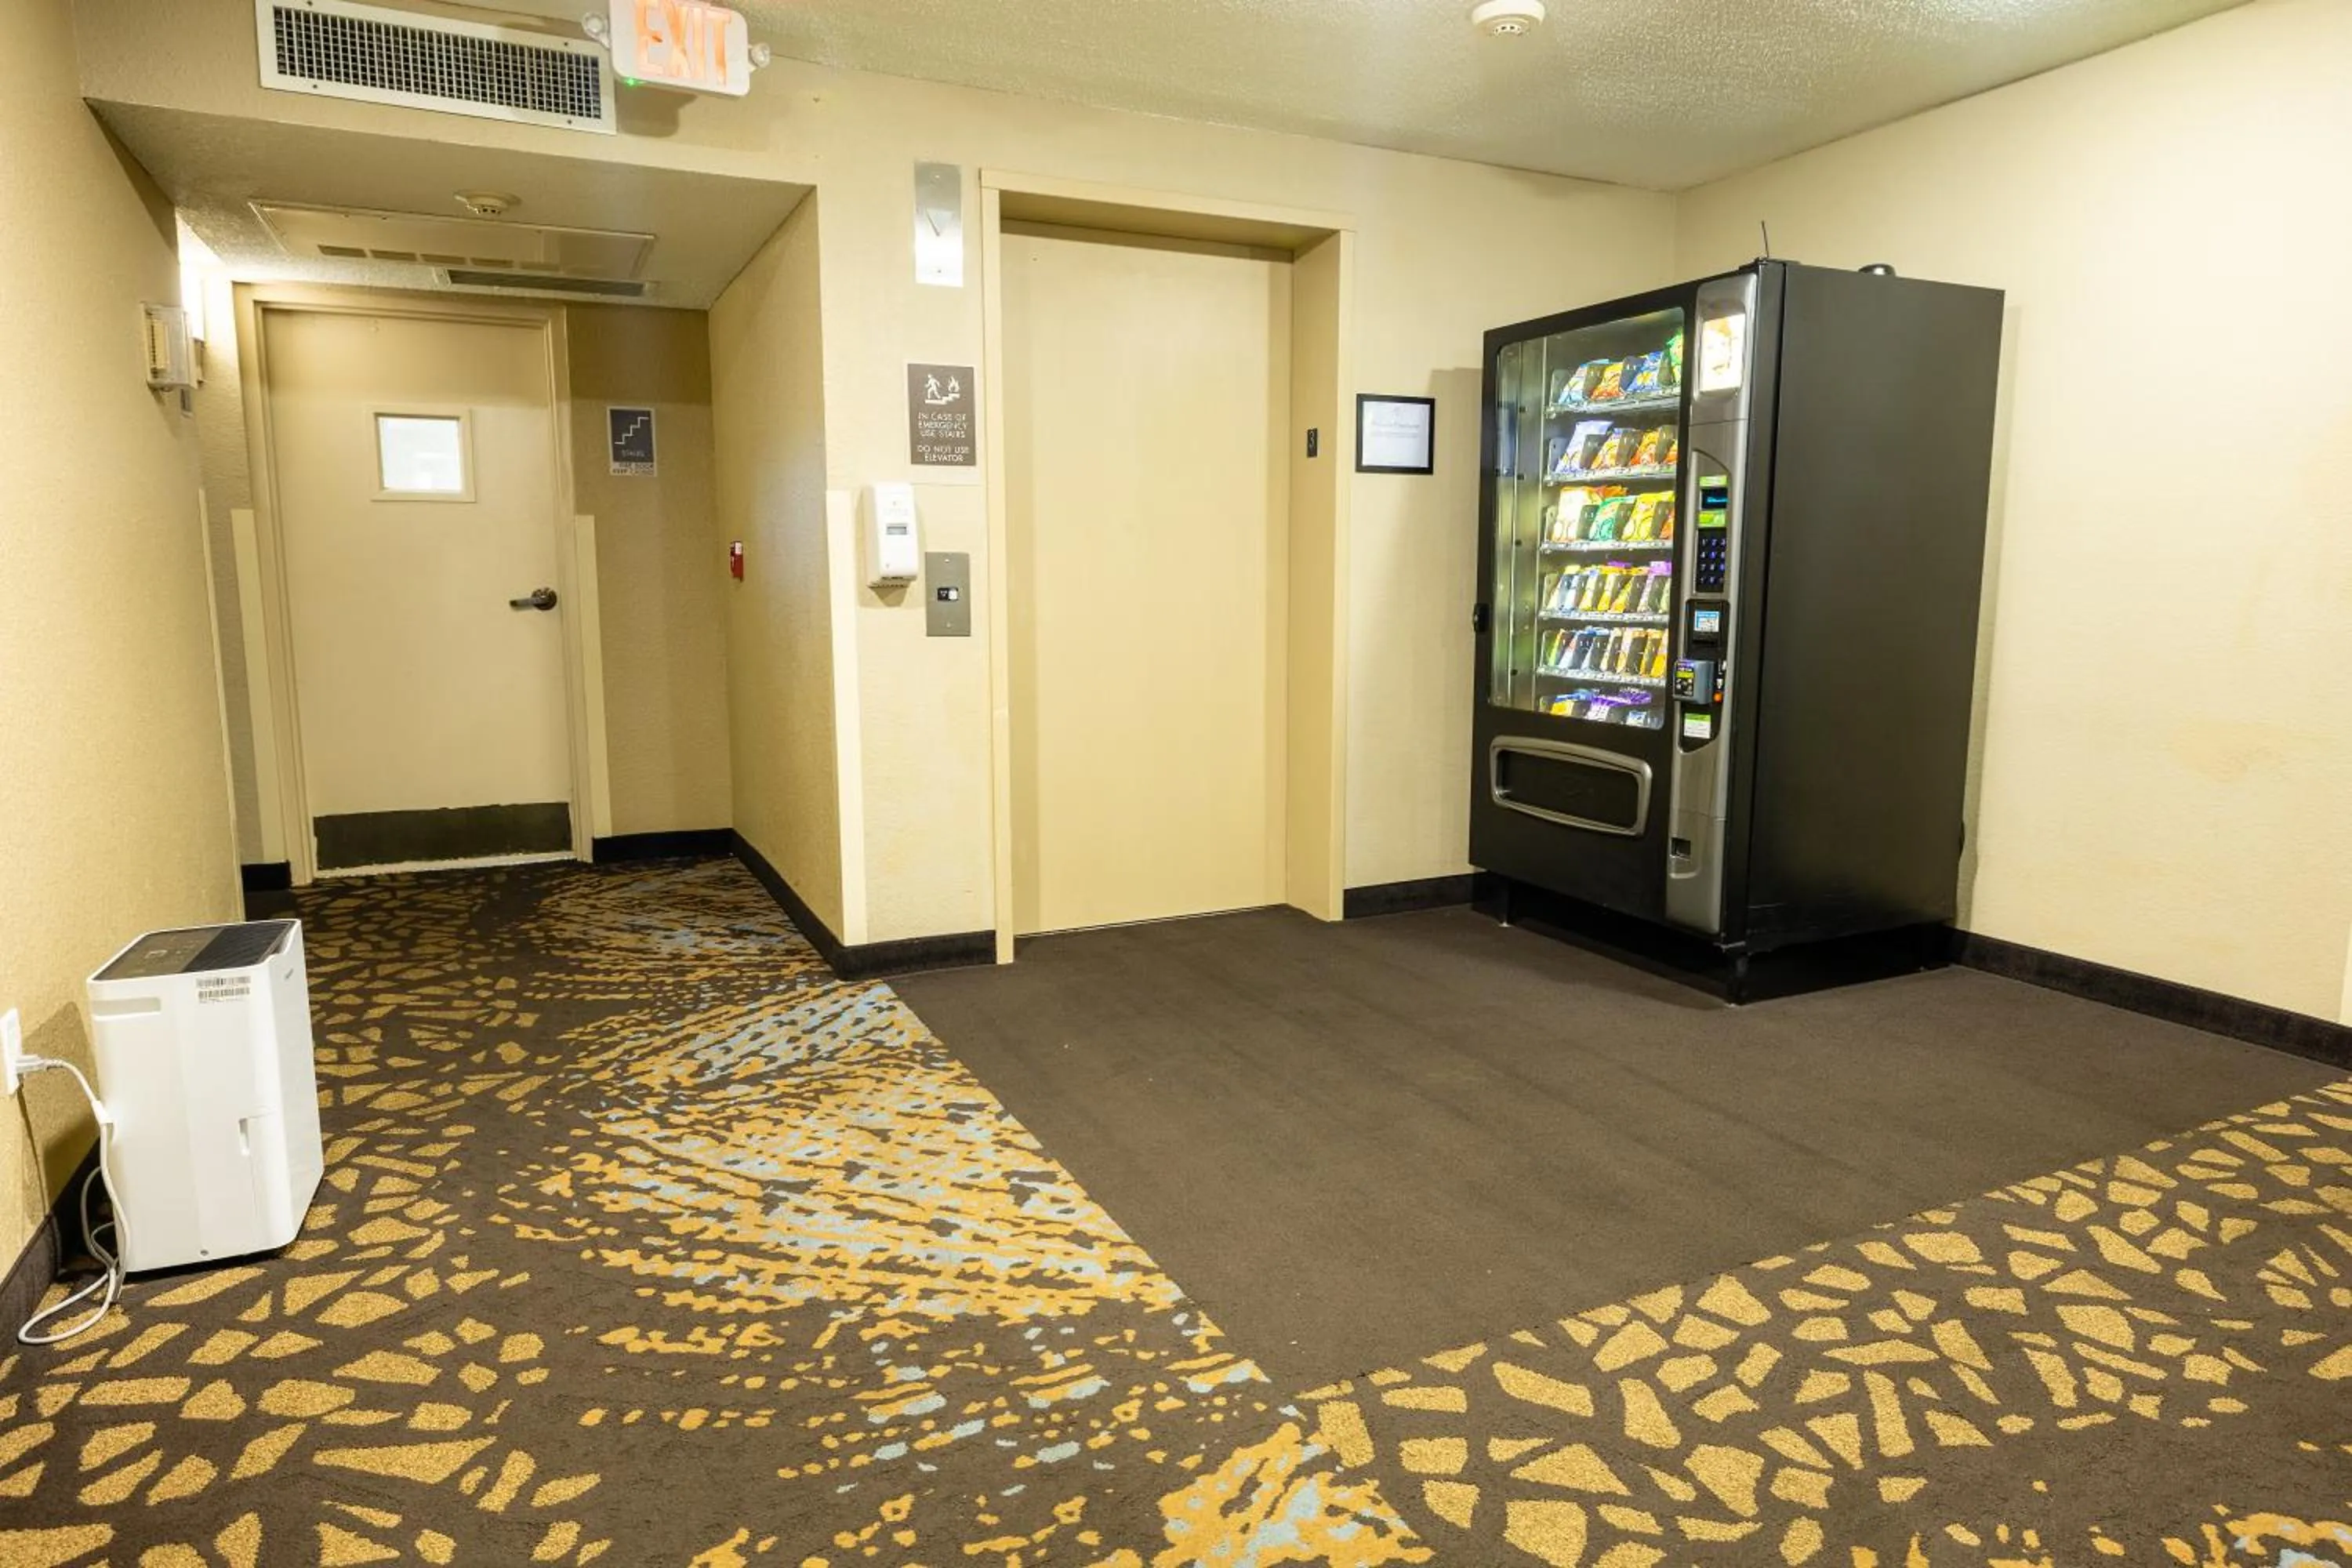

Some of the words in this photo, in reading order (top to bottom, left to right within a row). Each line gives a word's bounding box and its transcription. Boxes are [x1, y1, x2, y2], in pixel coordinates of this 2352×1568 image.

[633, 0, 731, 86] EXIT
[931, 412, 953, 421] CASE
[919, 420, 967, 430] EMERGENCY
[934, 445, 951, 454] NOT
[954, 445, 970, 454] USE
[924, 453, 964, 462] ELEVATOR
